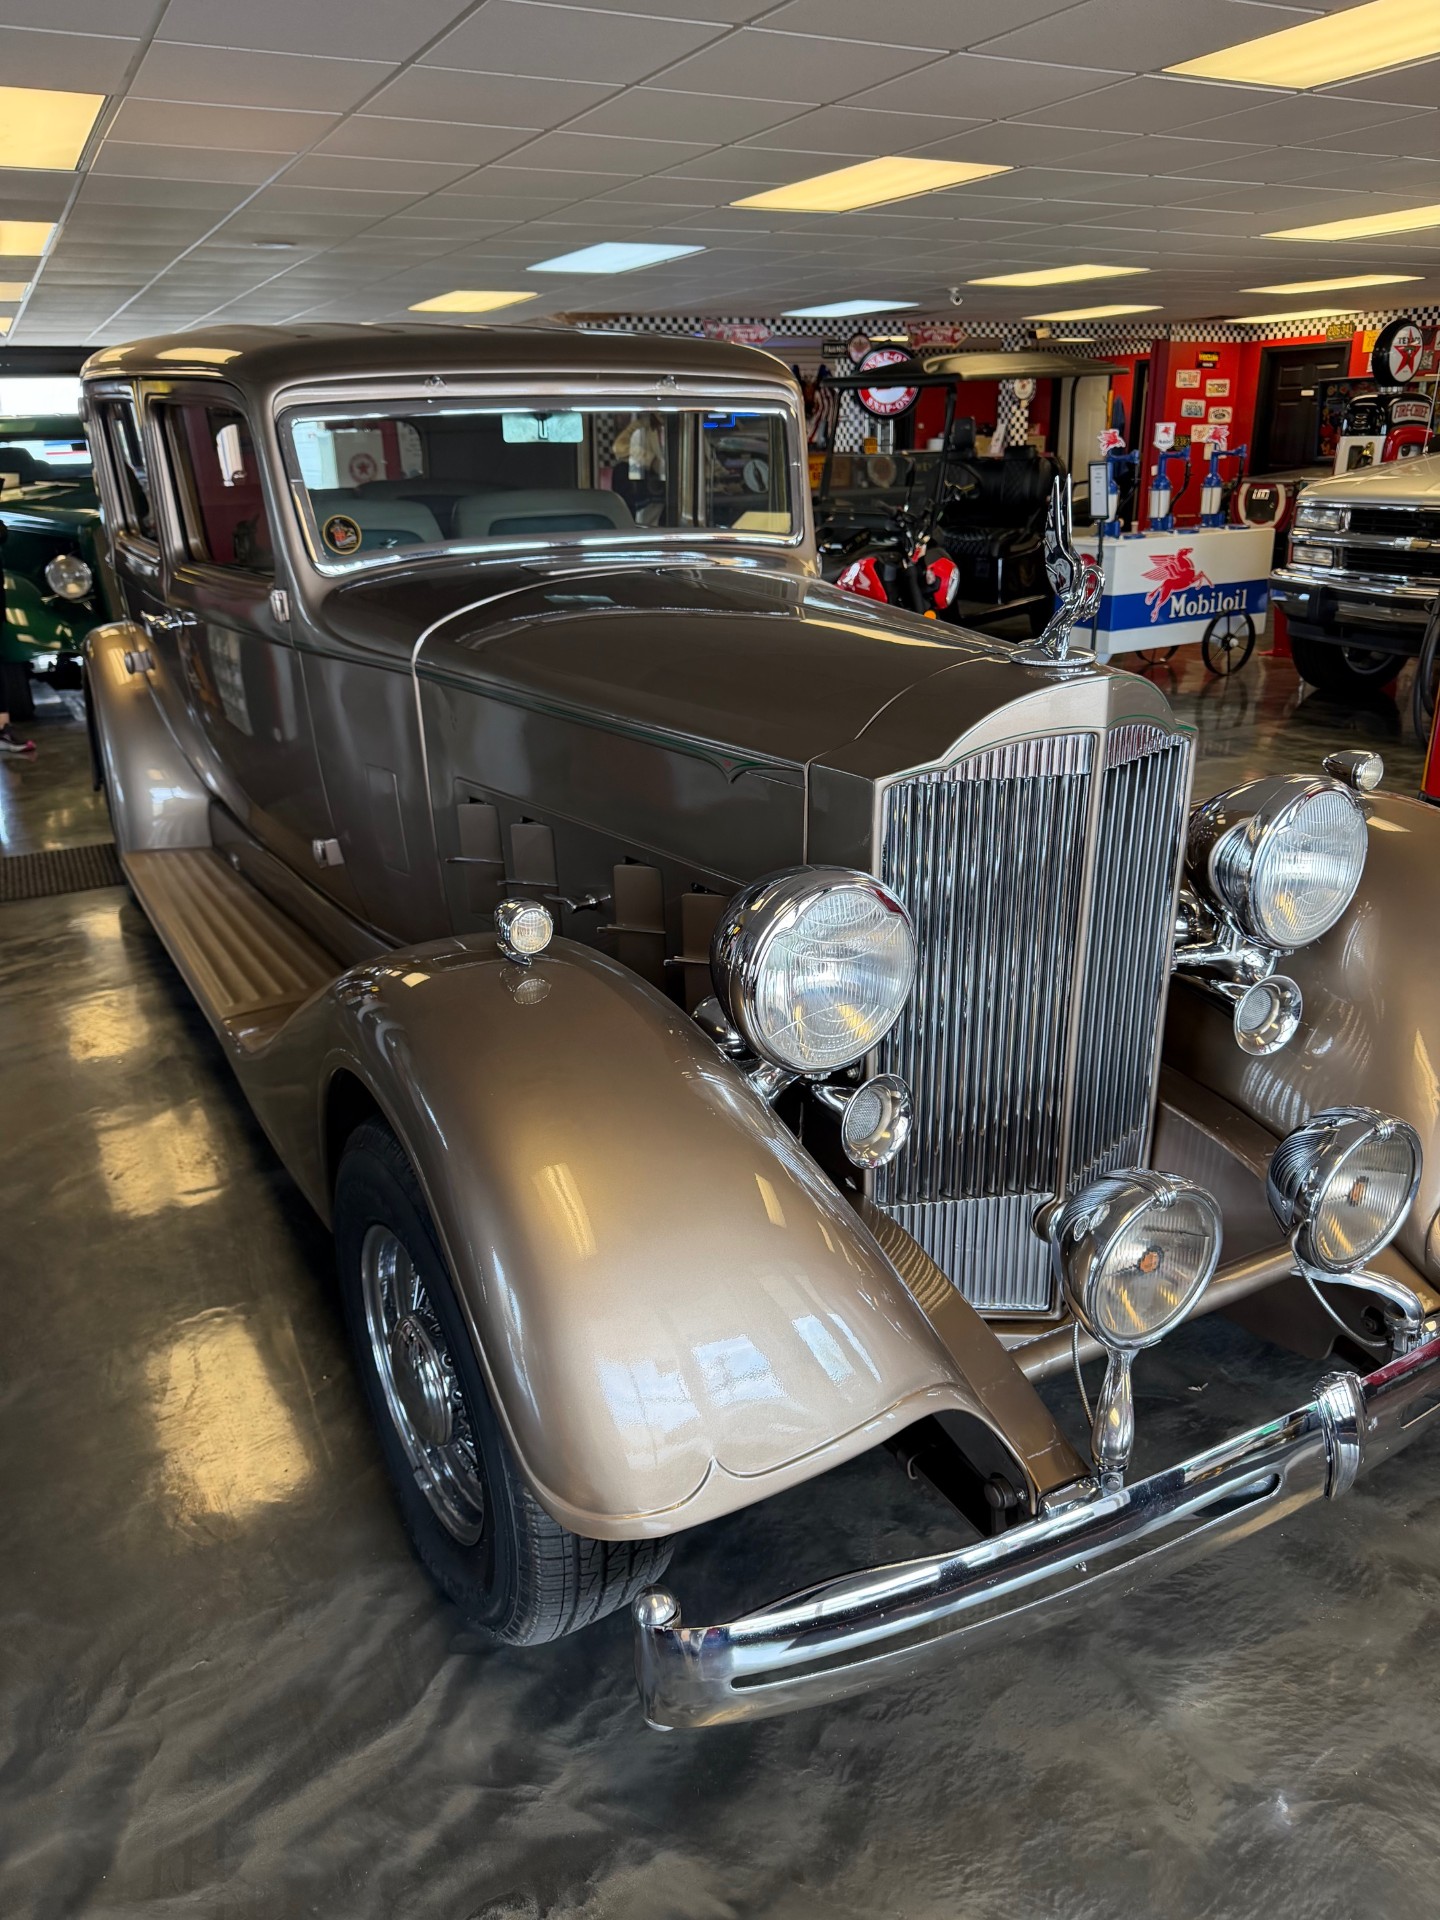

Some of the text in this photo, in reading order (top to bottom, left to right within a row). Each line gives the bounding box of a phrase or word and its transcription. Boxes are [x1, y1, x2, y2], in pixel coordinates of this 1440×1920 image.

[866, 394, 911, 413] SNAP-ON
[1394, 404, 1429, 419] FIRE-CHIEF
[1168, 588, 1248, 619] Mobiloil
